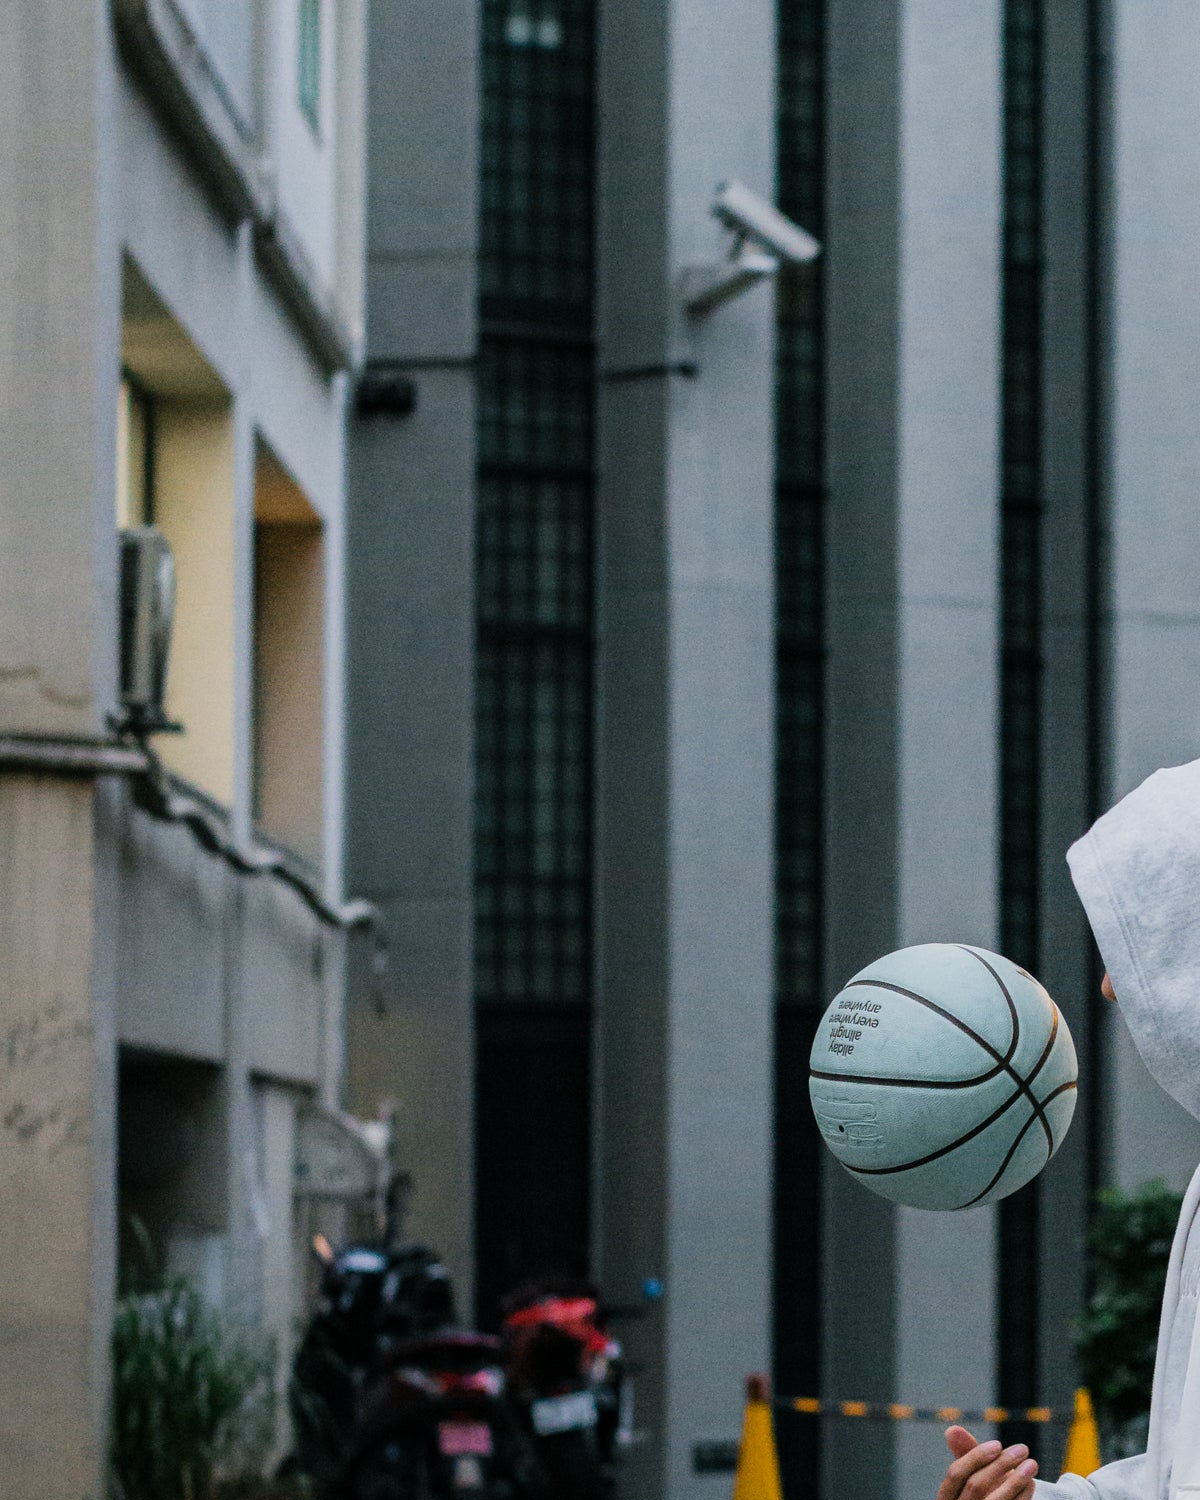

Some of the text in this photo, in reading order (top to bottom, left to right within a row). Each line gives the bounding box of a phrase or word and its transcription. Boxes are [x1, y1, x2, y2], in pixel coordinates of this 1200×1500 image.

[838, 1000, 882, 1013] anywhere
[828, 1013, 879, 1028] everywhere
[830, 1026, 862, 1042] allnight
[828, 1040, 854, 1056] allday
